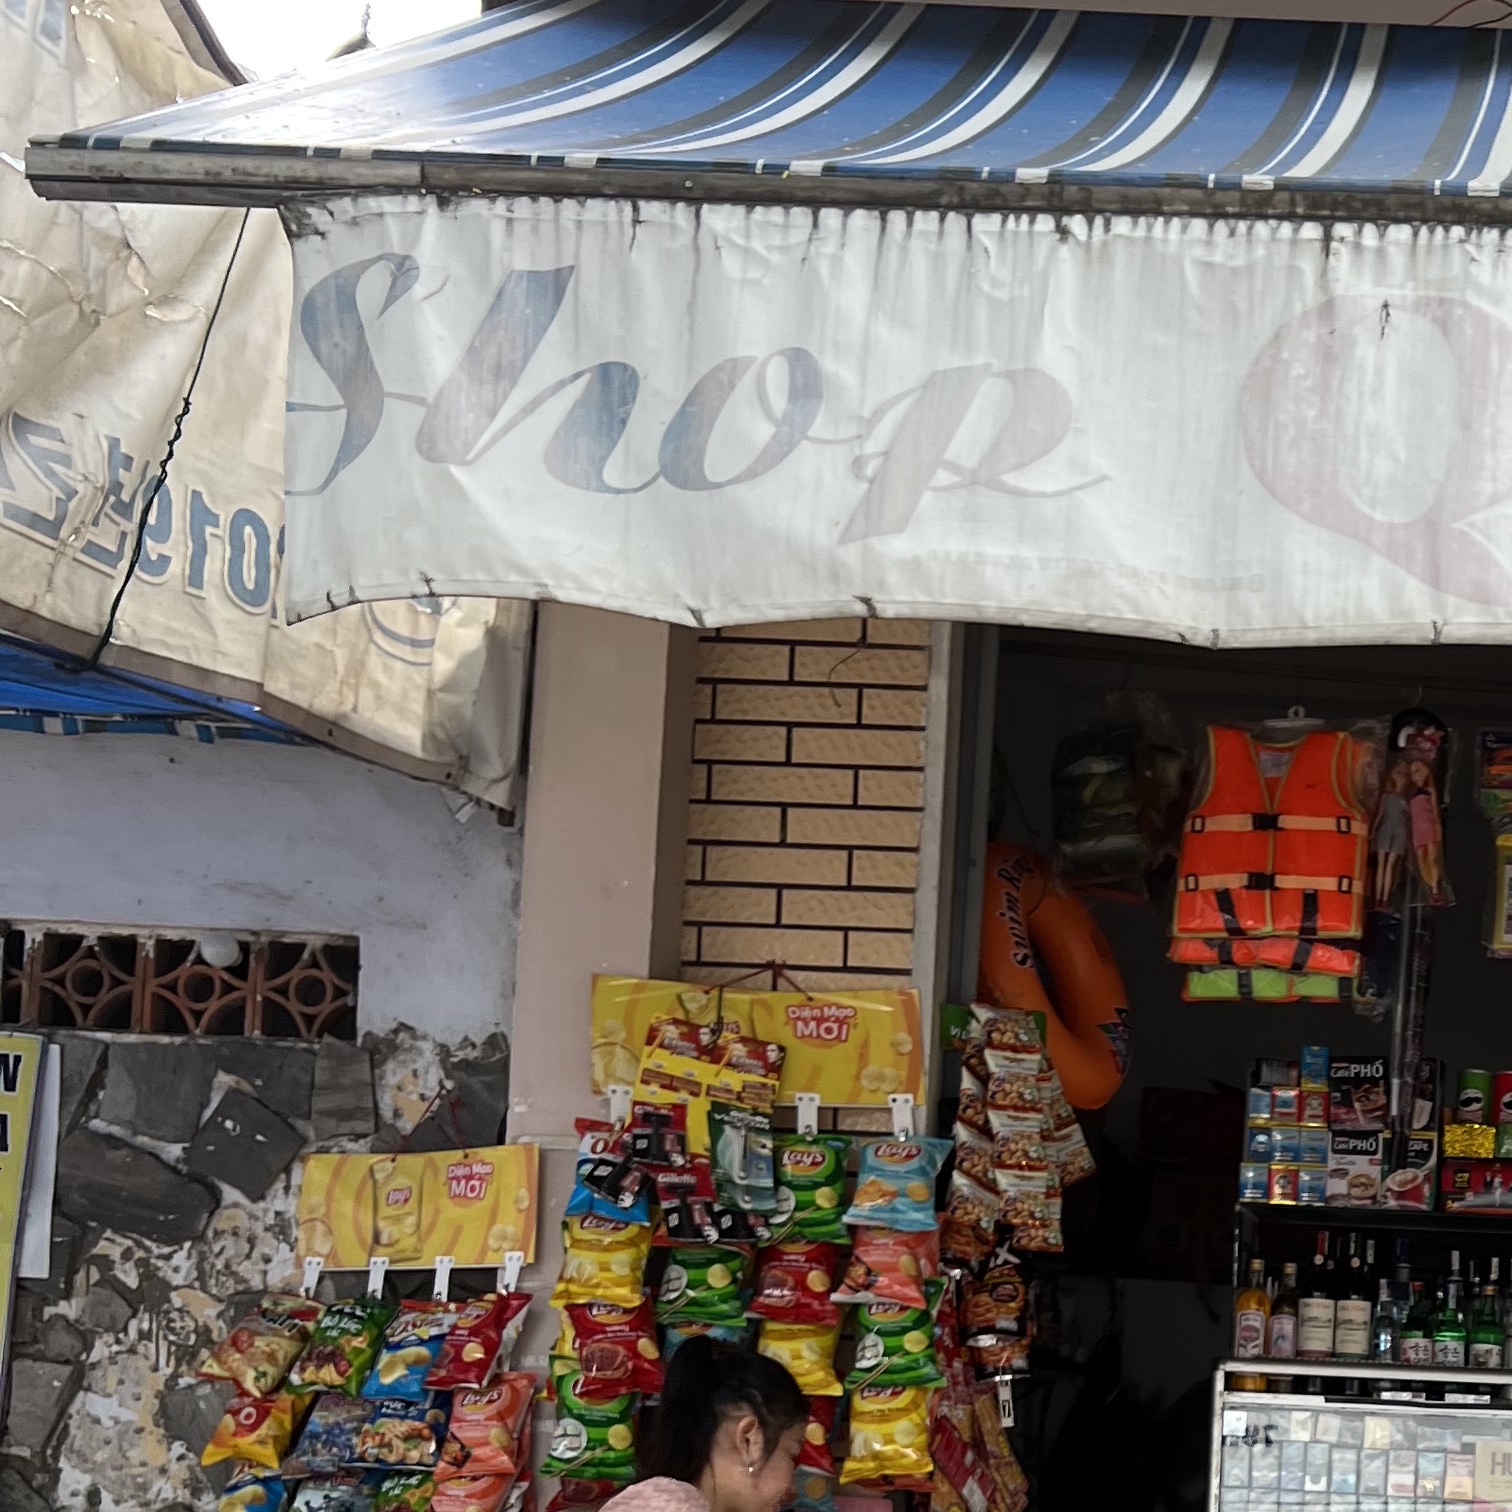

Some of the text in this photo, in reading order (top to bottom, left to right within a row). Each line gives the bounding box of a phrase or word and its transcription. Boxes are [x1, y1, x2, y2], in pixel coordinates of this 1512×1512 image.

[286, 253, 1110, 545] Shop
[796, 1019, 850, 1041] MỚI
[1349, 1059, 1384, 1078] PHỐ
[449, 1177, 487, 1200] MỚI
[657, 1172, 698, 1186] Gillette
